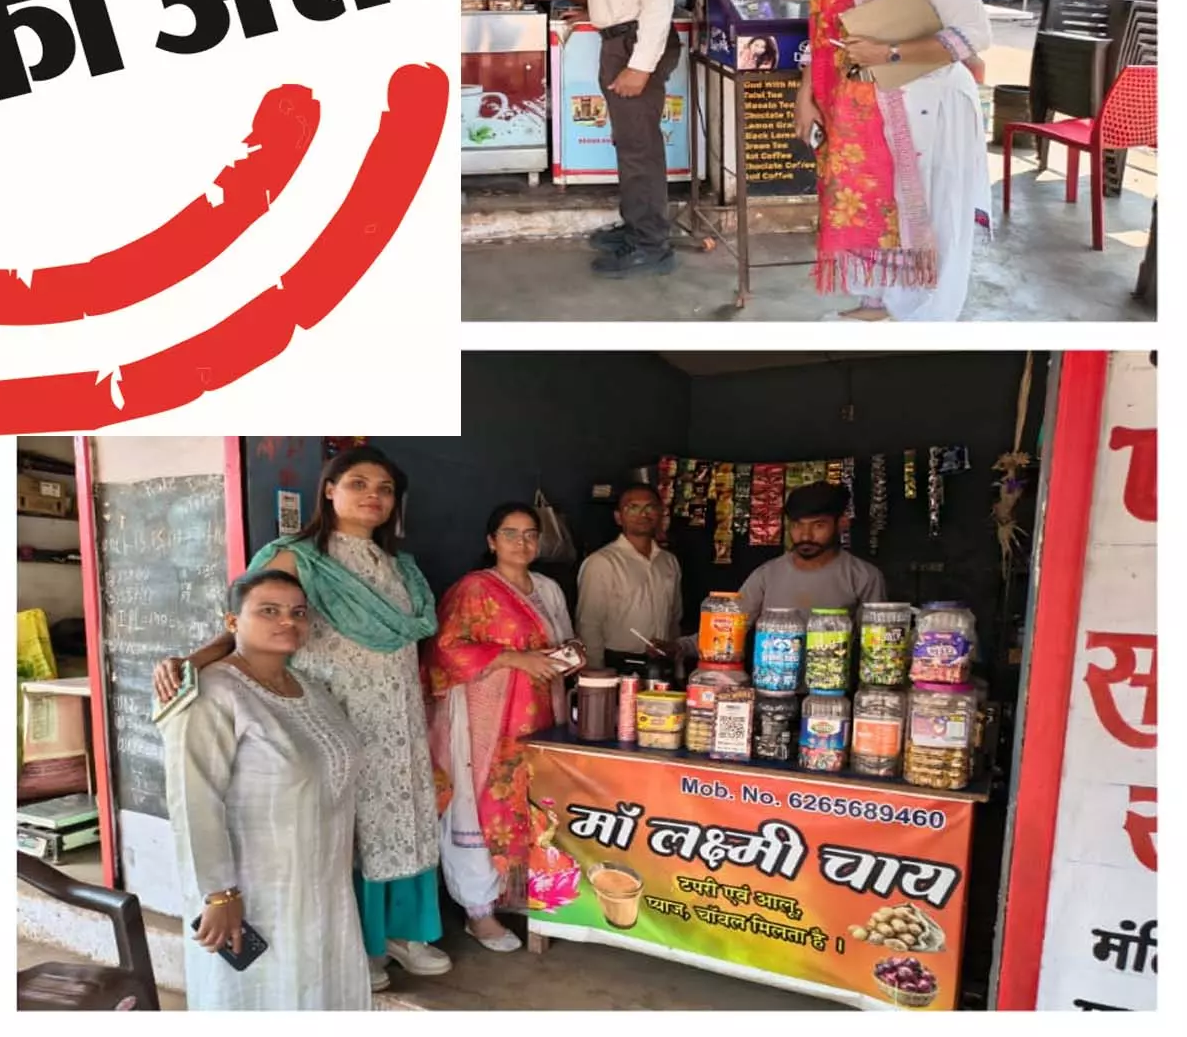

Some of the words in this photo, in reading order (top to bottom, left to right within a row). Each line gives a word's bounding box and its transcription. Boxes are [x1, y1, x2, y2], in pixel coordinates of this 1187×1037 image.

[681, 775, 734, 800] Mob.
[742, 785, 780, 807] No.
[788, 791, 945, 831] 6265689460
[646, 817, 809, 881] लक्ष्मी
[820, 843, 961, 910] चाय
[677, 875, 719, 897] टपरी
[722, 883, 751, 906] एवं
[750, 915, 807, 946] मिलता
[808, 926, 829, 952] है
